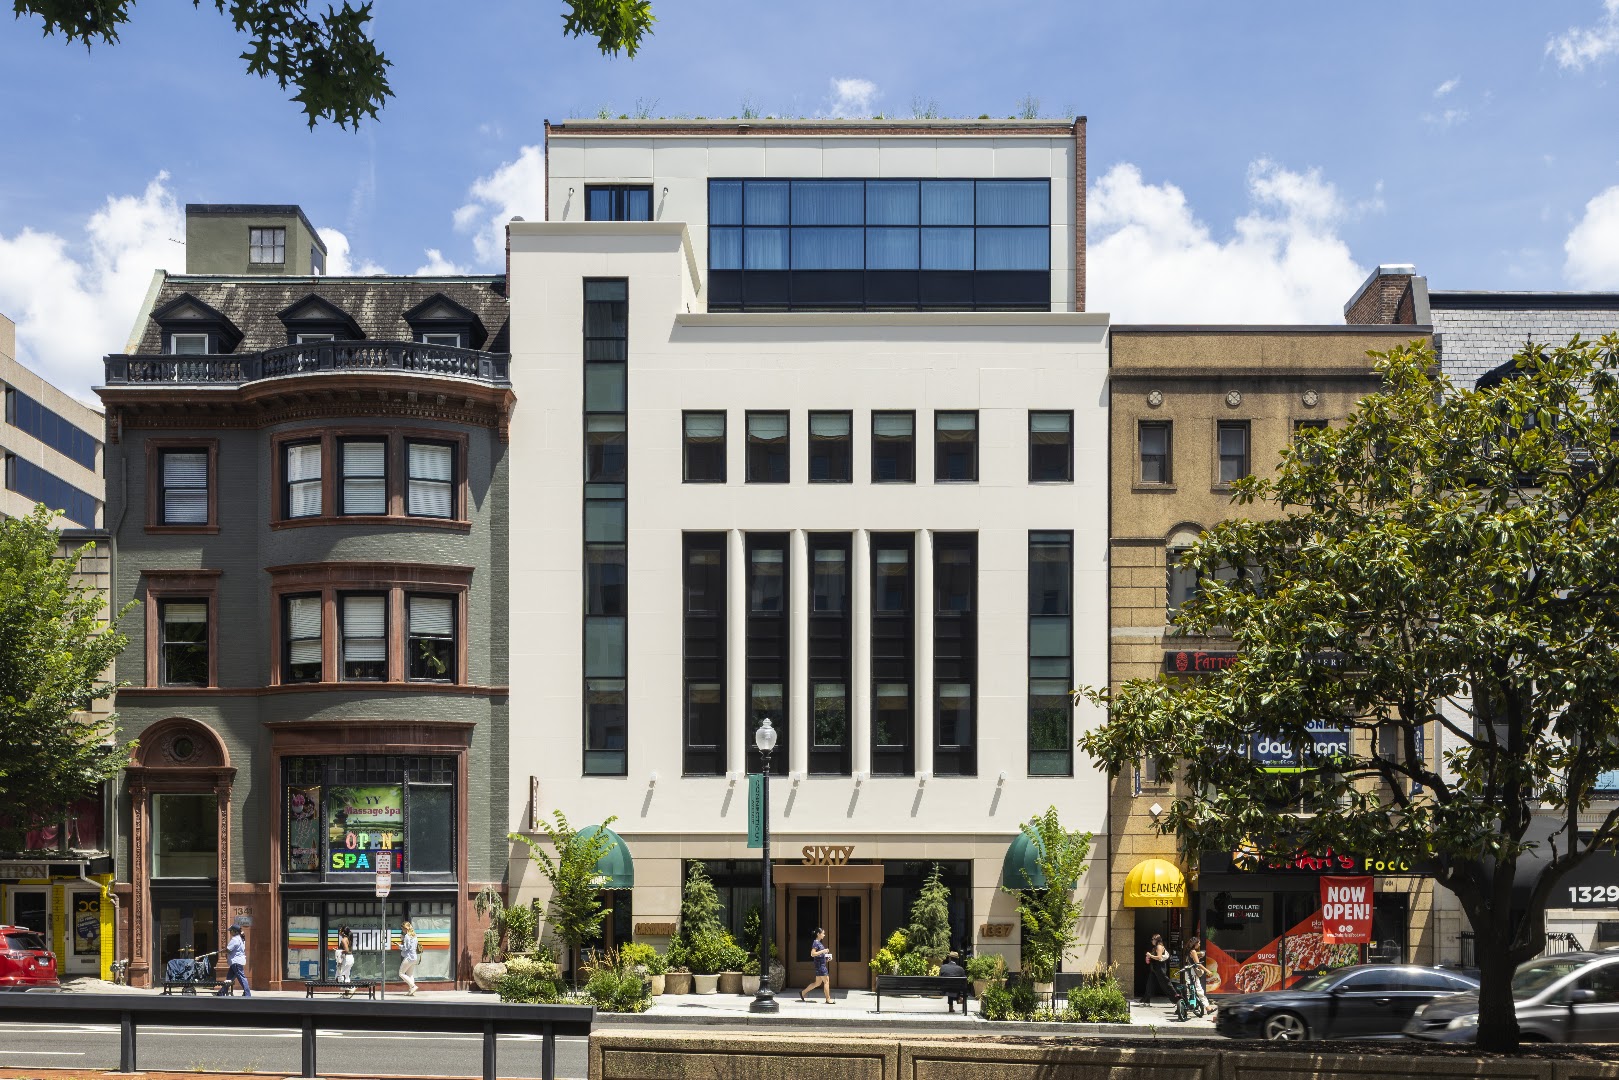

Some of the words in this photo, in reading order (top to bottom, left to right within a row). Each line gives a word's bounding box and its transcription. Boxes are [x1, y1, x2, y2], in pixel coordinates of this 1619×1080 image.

[1257, 737, 1293, 759] day
[365, 796, 381, 805] YY
[344, 806, 383, 816] Massage
[384, 806, 401, 816] Spa
[345, 832, 393, 850] OPEN
[332, 852, 370, 869] SPA
[802, 845, 856, 866] SIXTY
[1140, 883, 1184, 893] CLEANERS
[1327, 886, 1366, 903] NOW
[1568, 885, 1619, 903] 1329
[234, 907, 253, 915] 1341
[1323, 903, 1370, 920] OPEN!
[980, 923, 1014, 938] 1337
